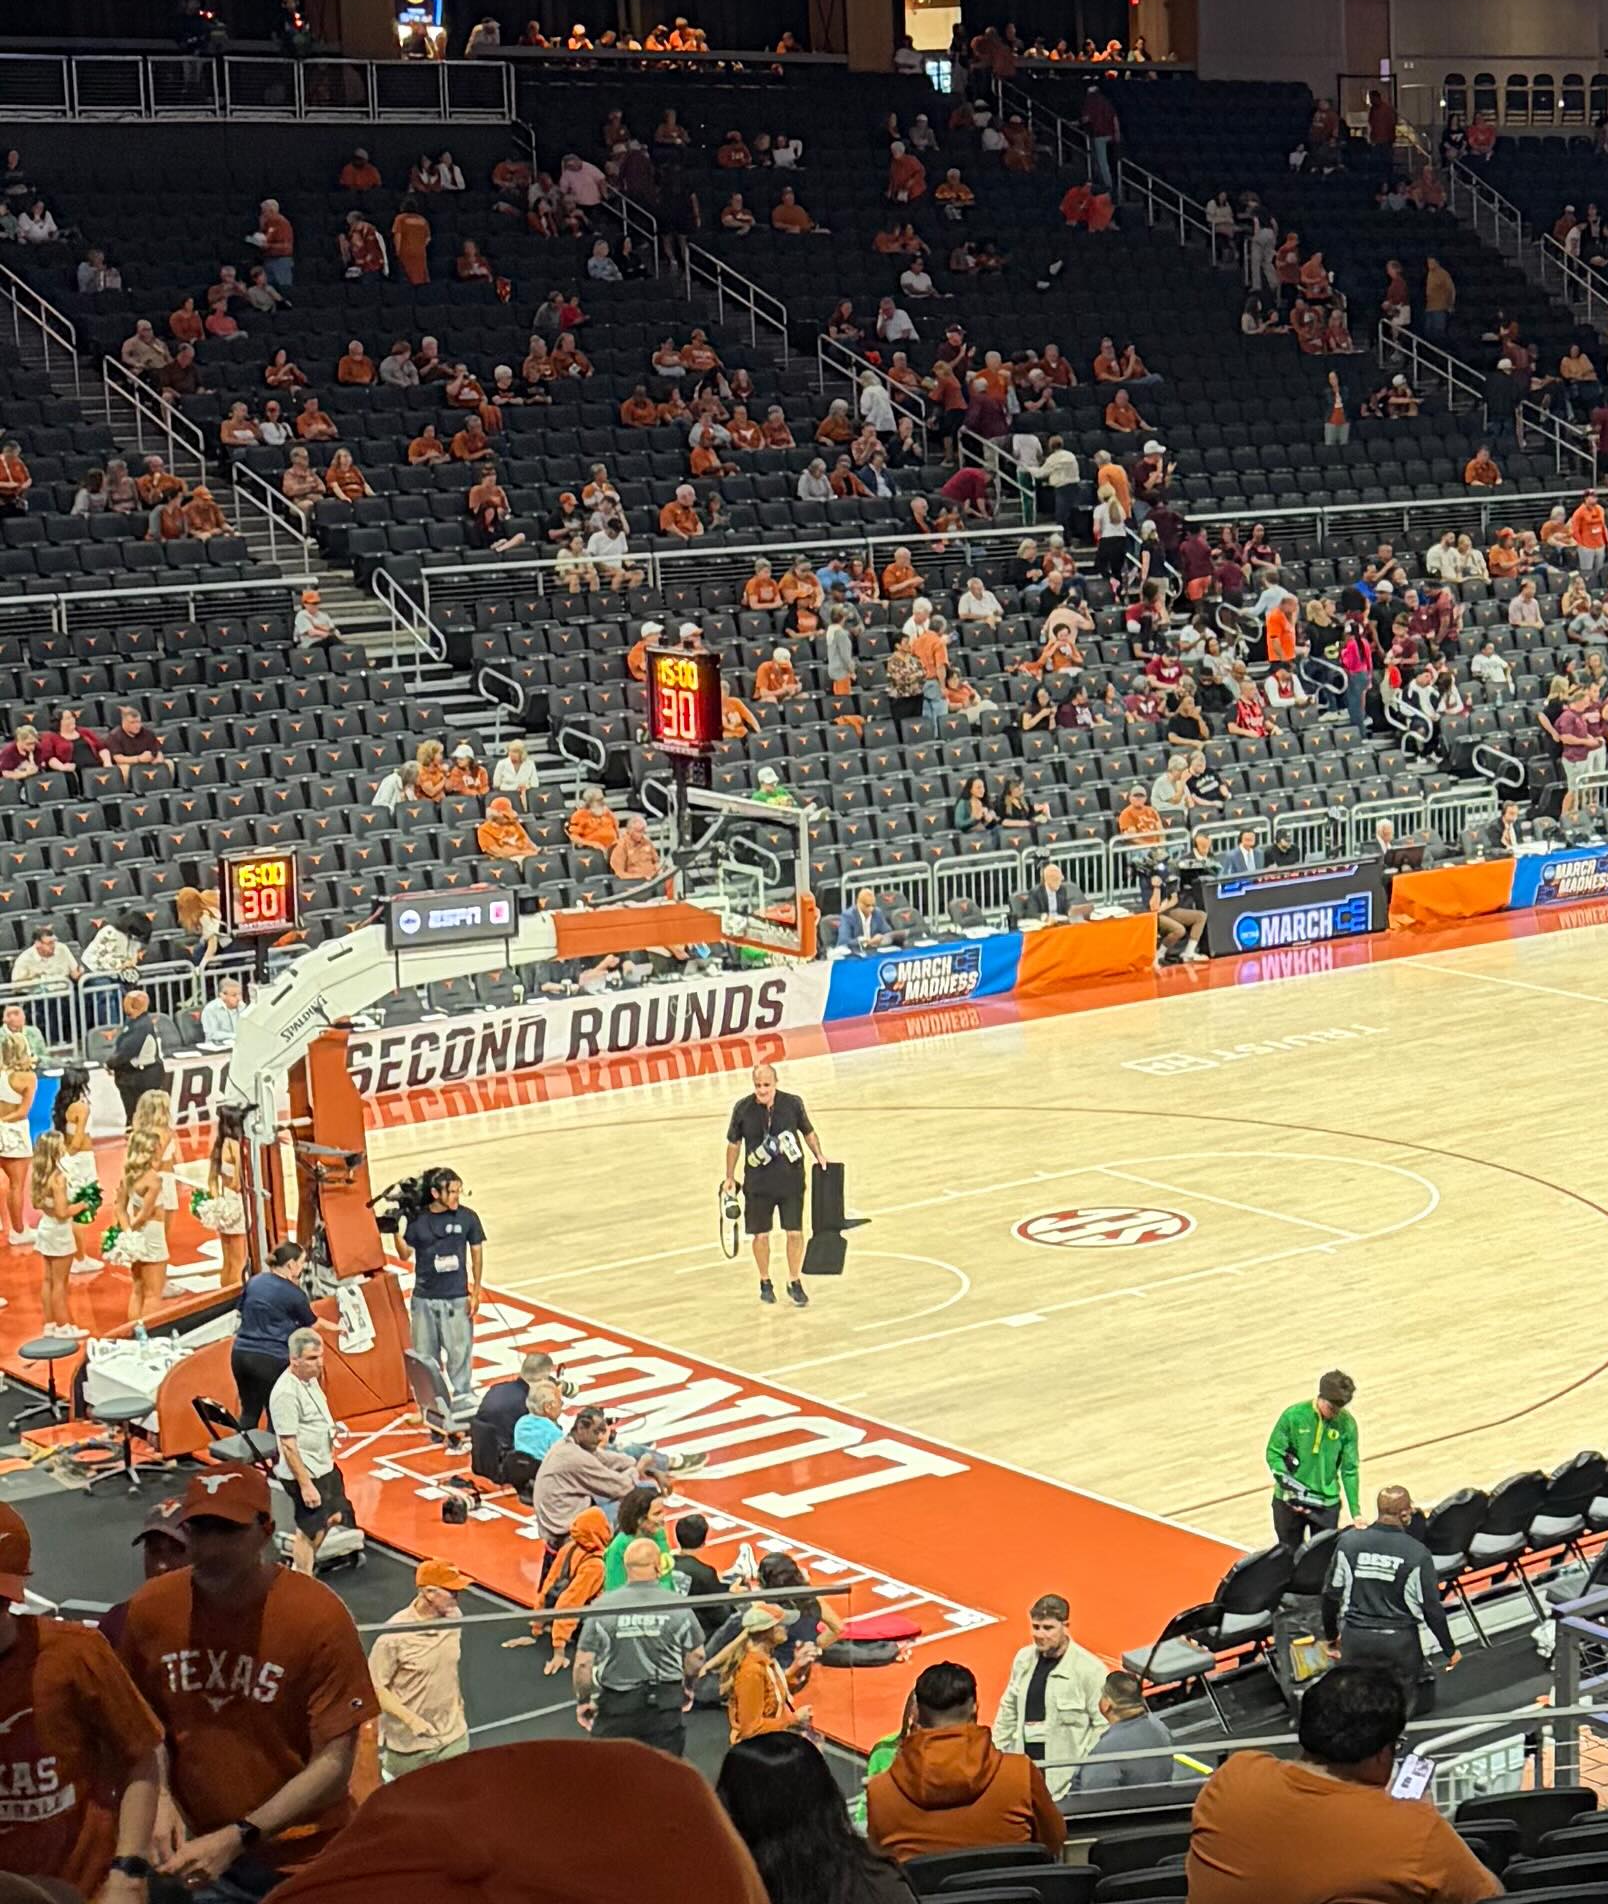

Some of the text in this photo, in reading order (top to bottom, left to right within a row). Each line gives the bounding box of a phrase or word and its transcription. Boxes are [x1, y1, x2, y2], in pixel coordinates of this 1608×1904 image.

[661, 688, 696, 739] 30
[1555, 859, 1597, 880] MARCH
[244, 888, 278, 918] 30
[1260, 907, 1333, 947] MARCH
[897, 955, 953, 982] MARCH
[904, 971, 979, 1001] MADNESS
[347, 977, 787, 1096] SECOND ROUNDS
[160, 1649, 285, 1704] TEXAS
